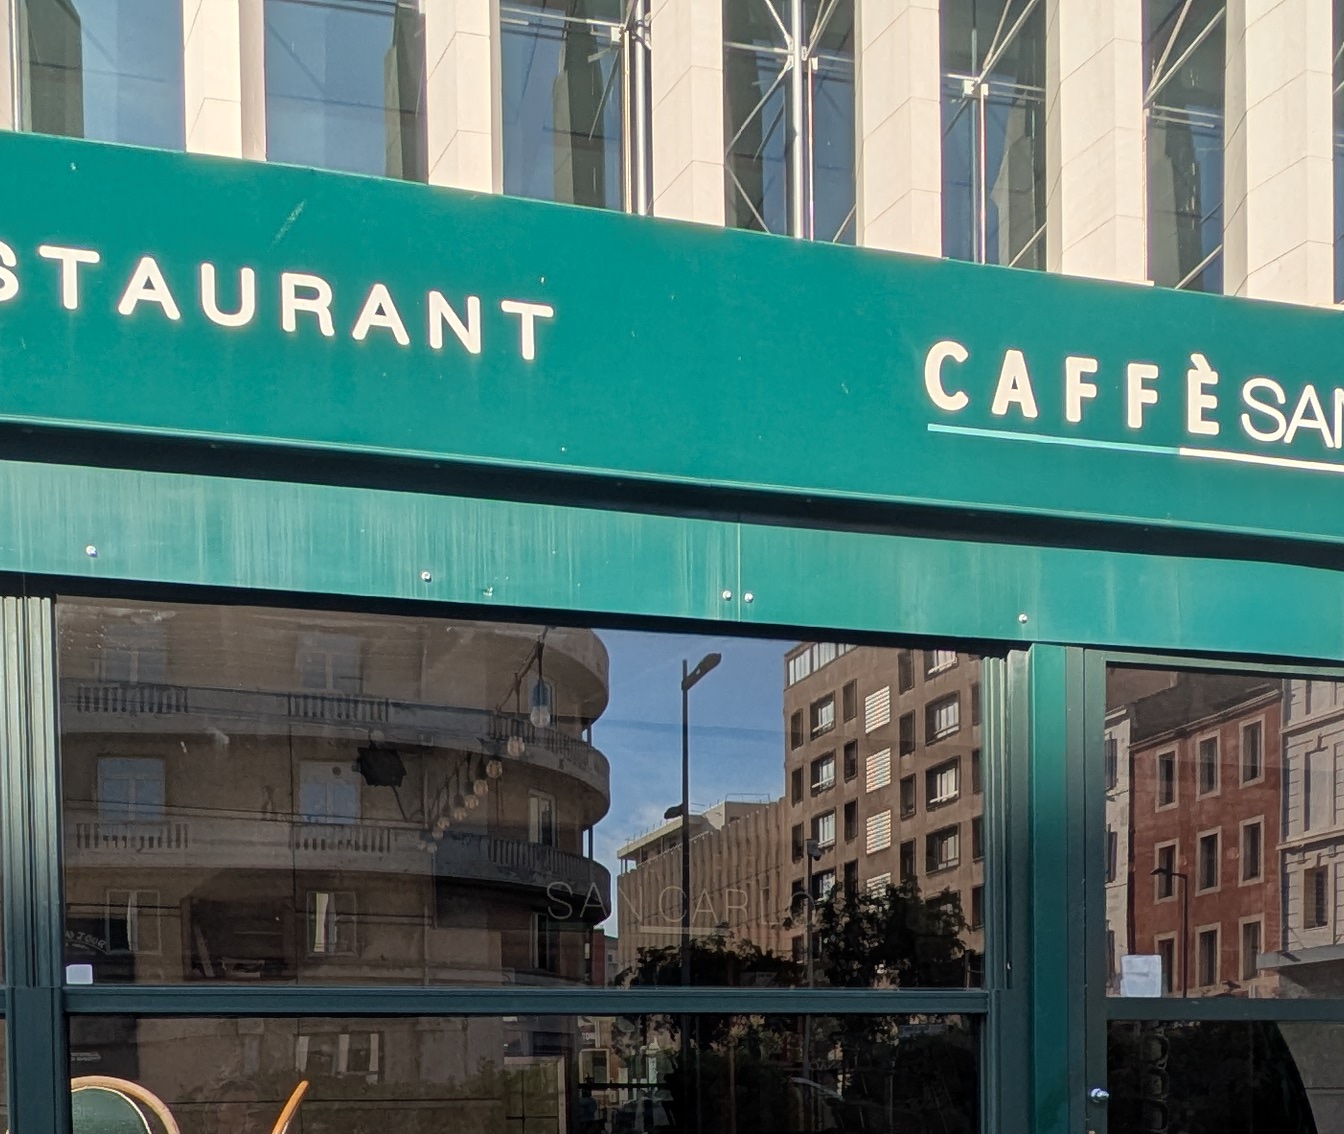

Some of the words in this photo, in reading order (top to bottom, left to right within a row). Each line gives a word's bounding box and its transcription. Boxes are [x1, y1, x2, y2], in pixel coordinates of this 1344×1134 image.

[923, 339, 1220, 437] CAFFÈ
[545, 880, 644, 924] SAN
[657, 884, 816, 928] CARLO
